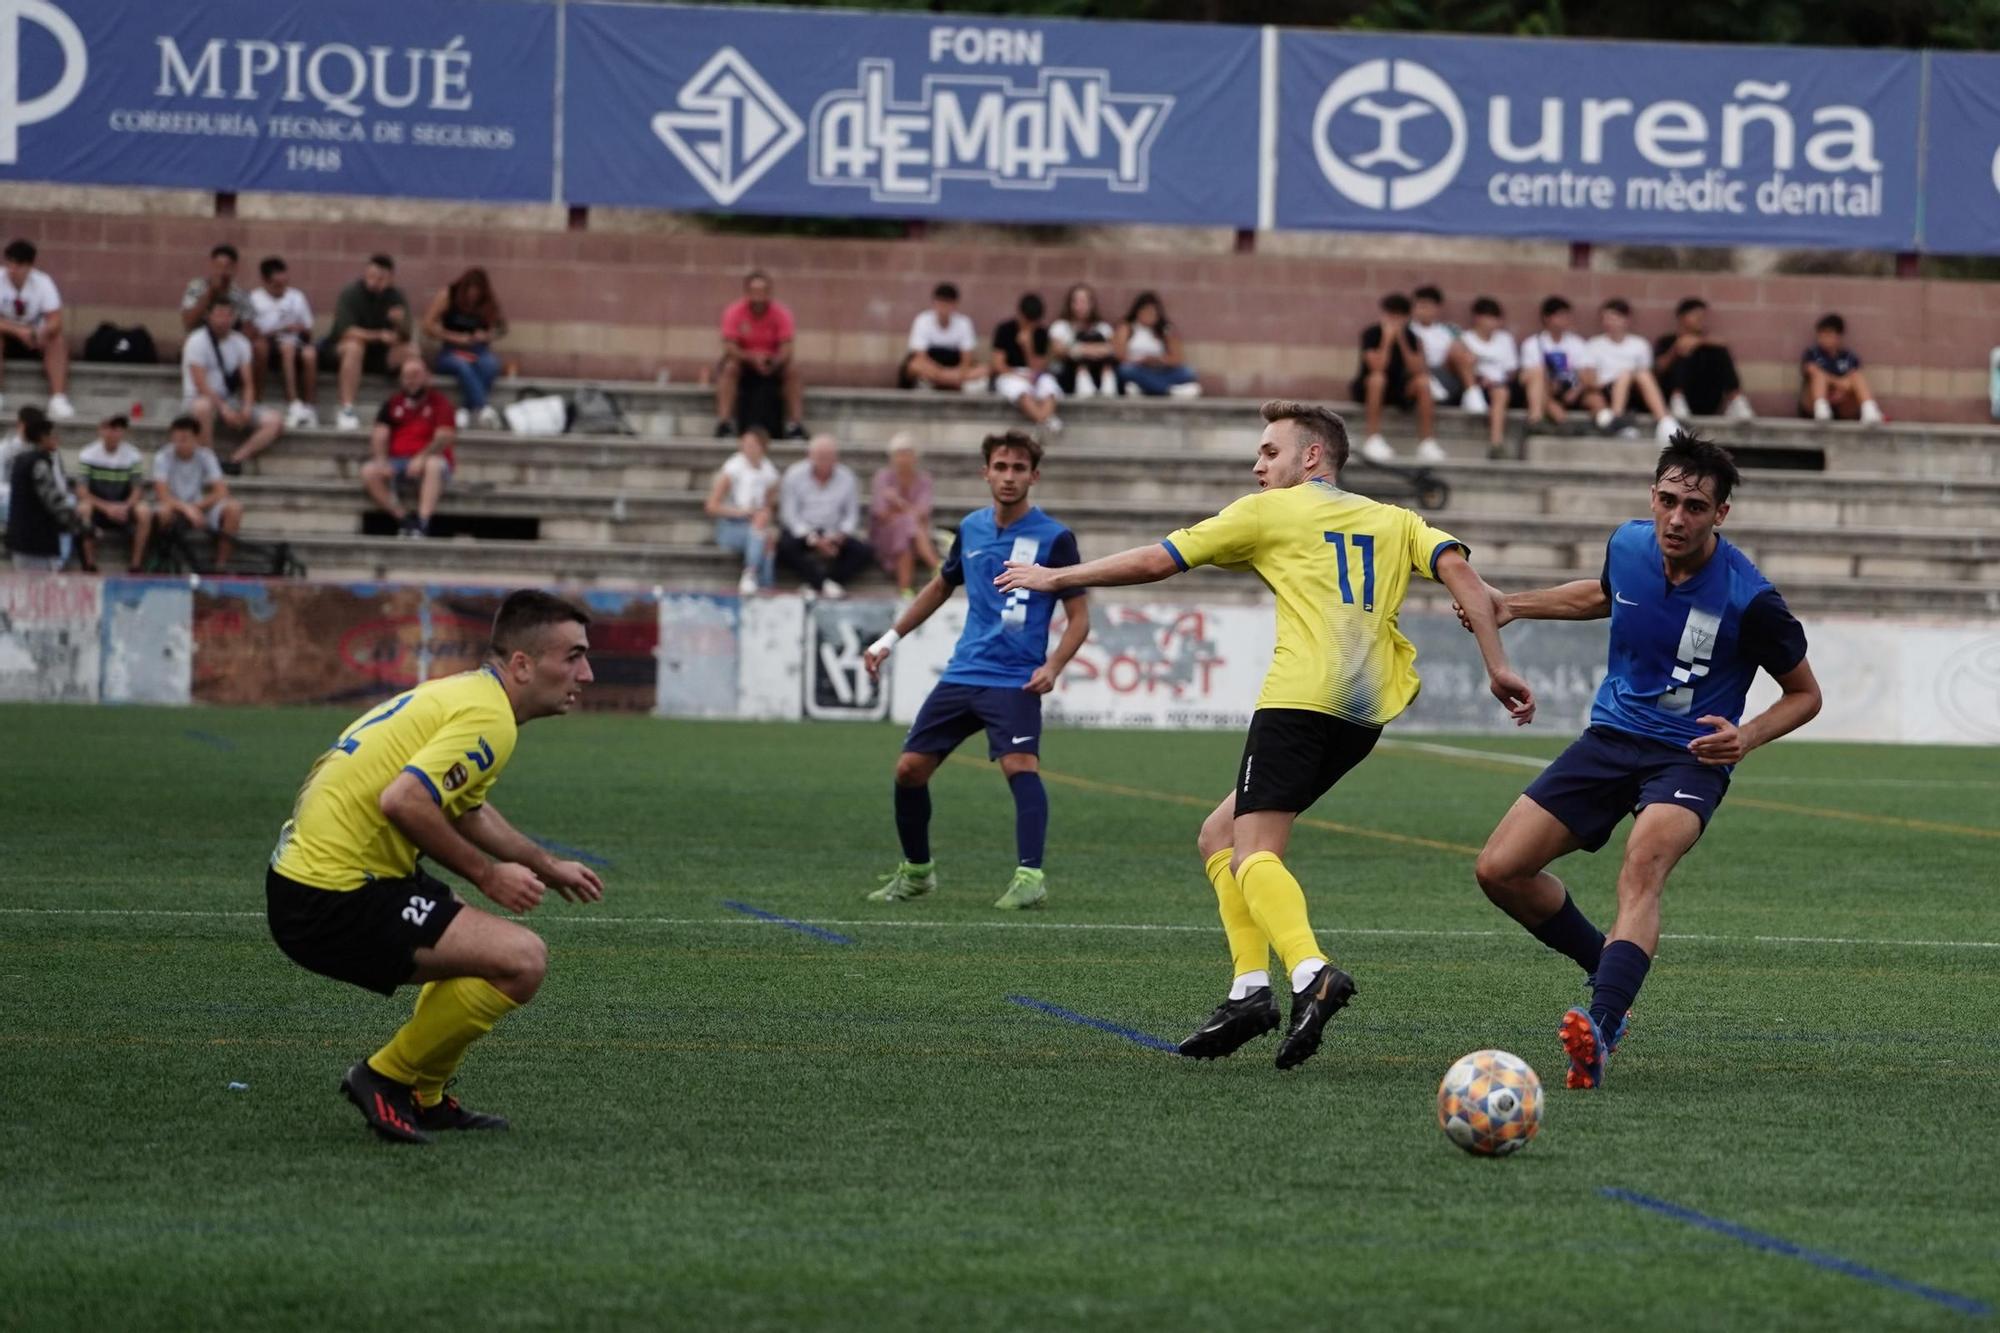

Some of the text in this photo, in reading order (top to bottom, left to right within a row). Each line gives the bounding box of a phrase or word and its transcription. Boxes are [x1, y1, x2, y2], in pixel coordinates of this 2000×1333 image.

[928, 28, 1043, 66] FORN
[153, 35, 473, 116] MPIQUÉ
[373, 120, 405, 143] DE
[411, 125, 515, 149] SEGUROS
[819, 67, 1160, 193] ALEMANY
[1488, 80, 1882, 172] ureña
[286, 147, 342, 173] 1948
[1487, 168, 1884, 217] centre mèdic dental
[1324, 531, 1376, 612] 11
[401, 894, 438, 927] 22
